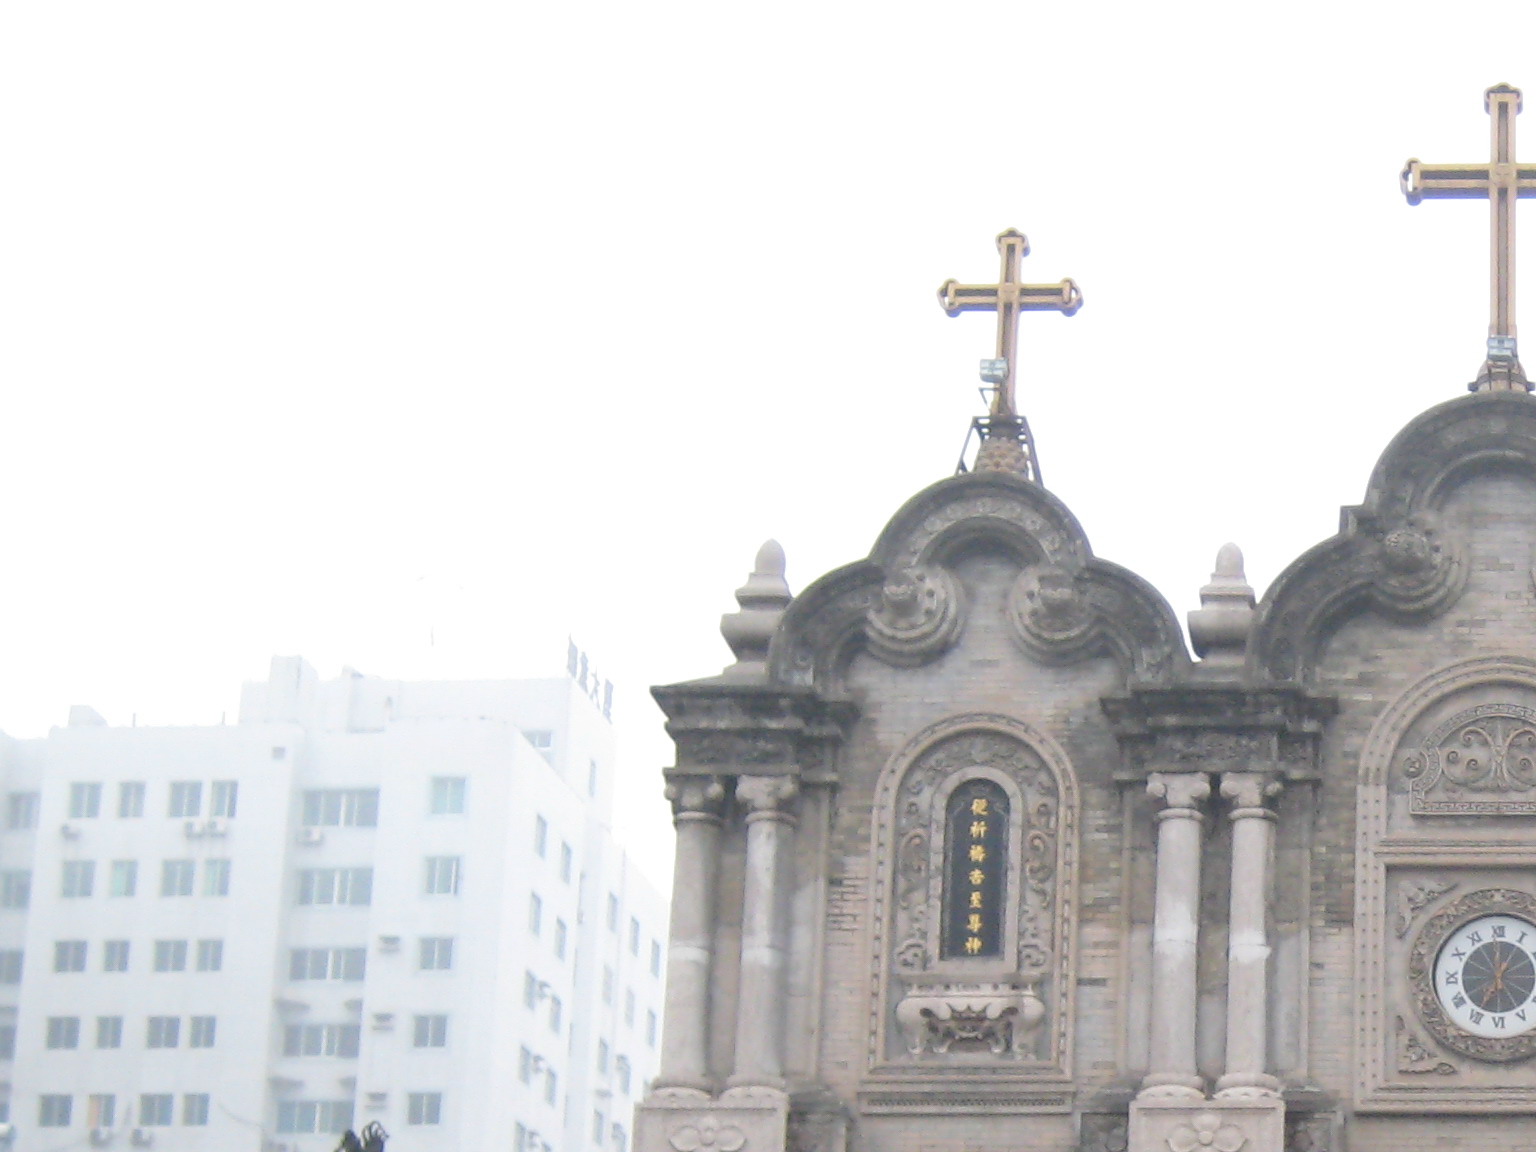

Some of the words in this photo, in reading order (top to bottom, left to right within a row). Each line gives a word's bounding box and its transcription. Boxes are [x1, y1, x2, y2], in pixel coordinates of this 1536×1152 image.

[1466, 931, 1483, 946] XI
[1451, 947, 1467, 962] X
[1491, 1016, 1506, 1029] VI
[1515, 1009, 1528, 1022] V
